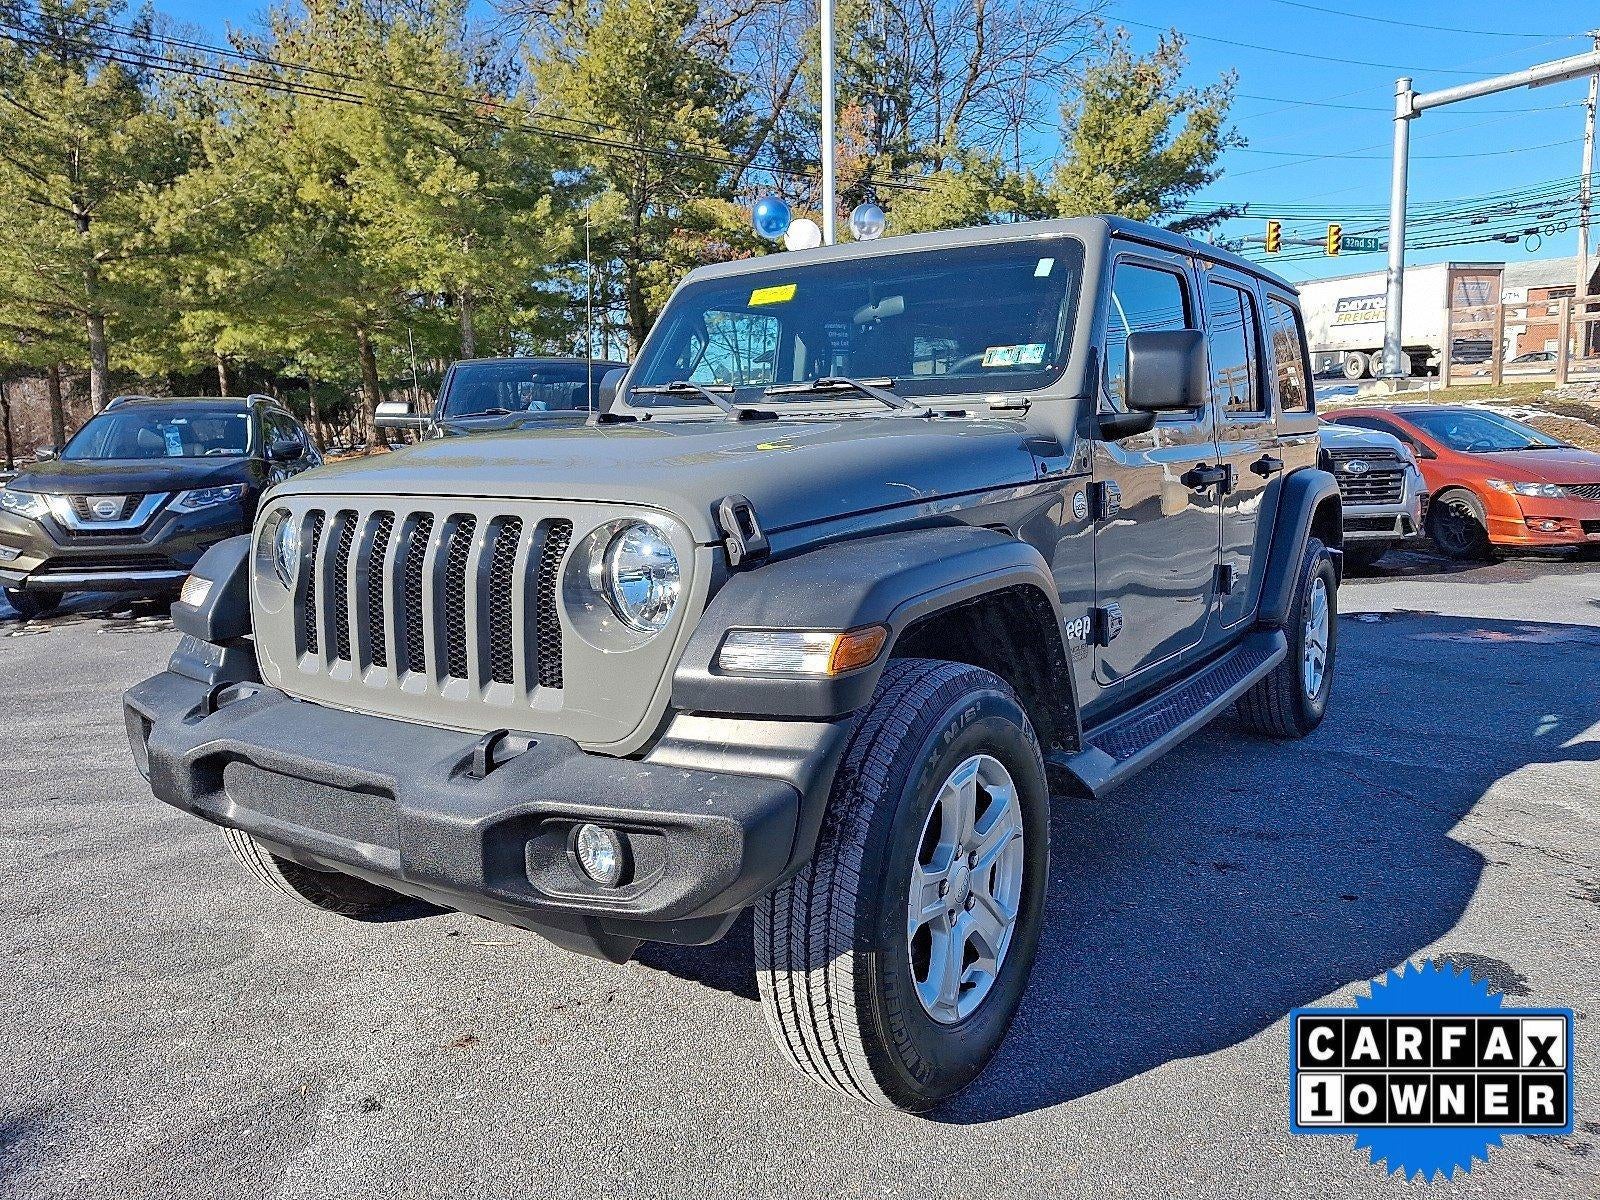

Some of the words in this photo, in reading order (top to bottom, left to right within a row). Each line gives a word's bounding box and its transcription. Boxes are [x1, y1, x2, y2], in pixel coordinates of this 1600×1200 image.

[1345, 238, 1365, 248] 32nd
[1367, 238, 1376, 249] St
[1338, 295, 1386, 312] DAYTO
[1064, 615, 1091, 640] eep
